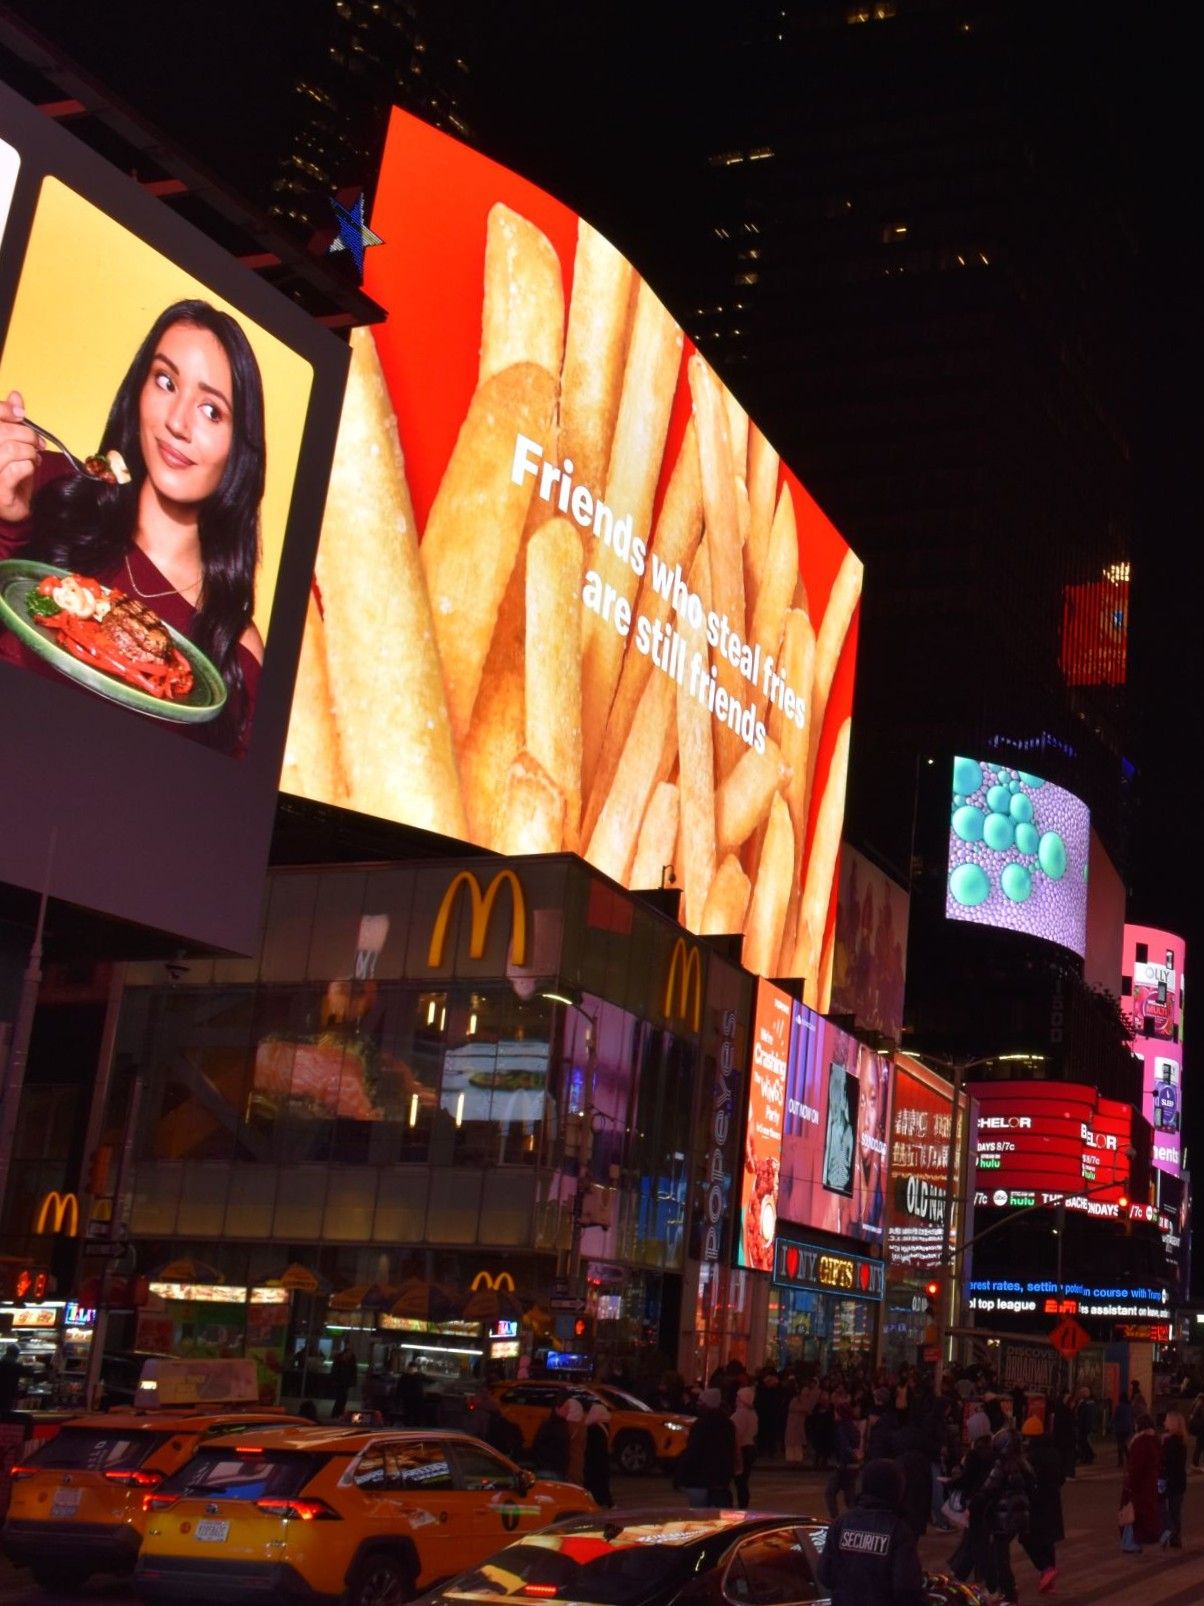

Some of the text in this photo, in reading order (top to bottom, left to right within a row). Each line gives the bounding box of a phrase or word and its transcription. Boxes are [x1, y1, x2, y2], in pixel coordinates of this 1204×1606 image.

[511, 433, 807, 729] Friends who steal fries
[582, 570, 766, 755] are still friends
[1145, 963, 1170, 983] OLLY
[996, 1141, 1015, 1152] 8/7c
[980, 1158, 1000, 1169] hulu
[906, 1176, 928, 1218] OLD
[1010, 1196, 1035, 1206] hulu
[819, 1253, 855, 1288] GIFTS
[992, 1281, 1024, 1293] rates,
[1093, 1288, 1128, 1298] course
[1130, 1288, 1147, 1299] with
[978, 1298, 994, 1311] top
[996, 1298, 1037, 1312] league
[1090, 1305, 1137, 1316] assistant
[841, 1531, 888, 1553] SECURITY
